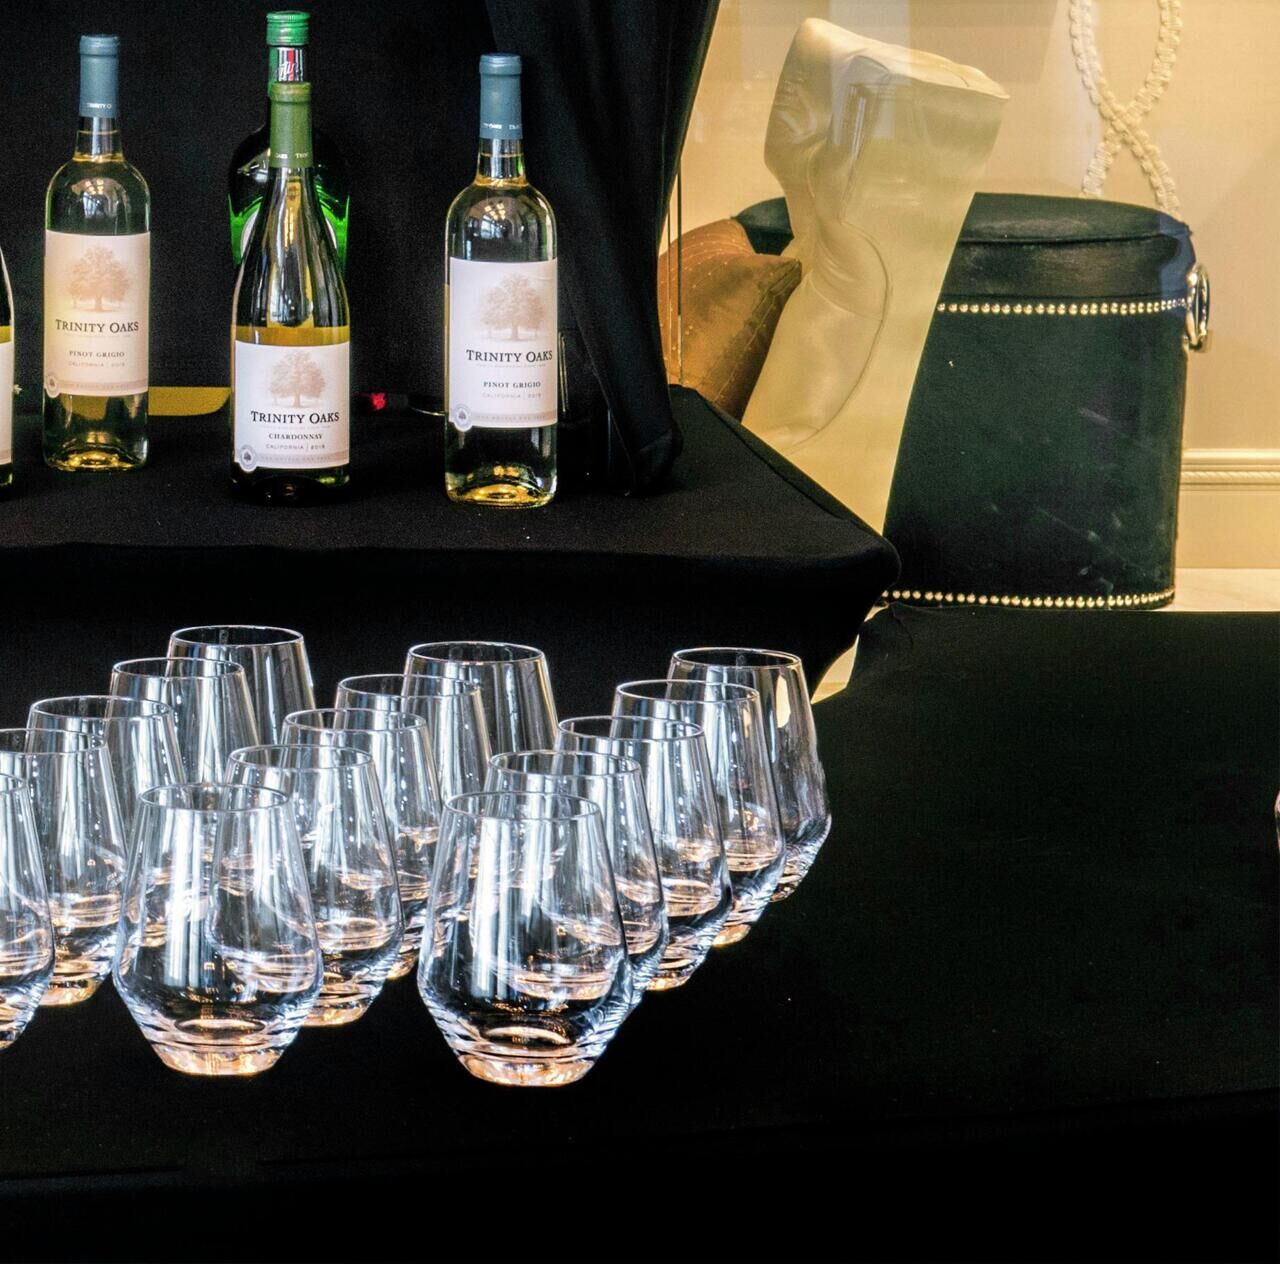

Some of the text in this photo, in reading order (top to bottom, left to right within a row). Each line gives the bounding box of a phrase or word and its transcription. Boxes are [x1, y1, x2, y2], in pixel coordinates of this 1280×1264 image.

[55, 318, 140, 334] TRINITY OAKS
[69, 350, 93, 358] PINOT
[465, 349, 553, 363] TRINITY OAKS
[483, 381, 542, 389] PINOT GRIGIO
[250, 410, 340, 425] TRINITY OAKS
